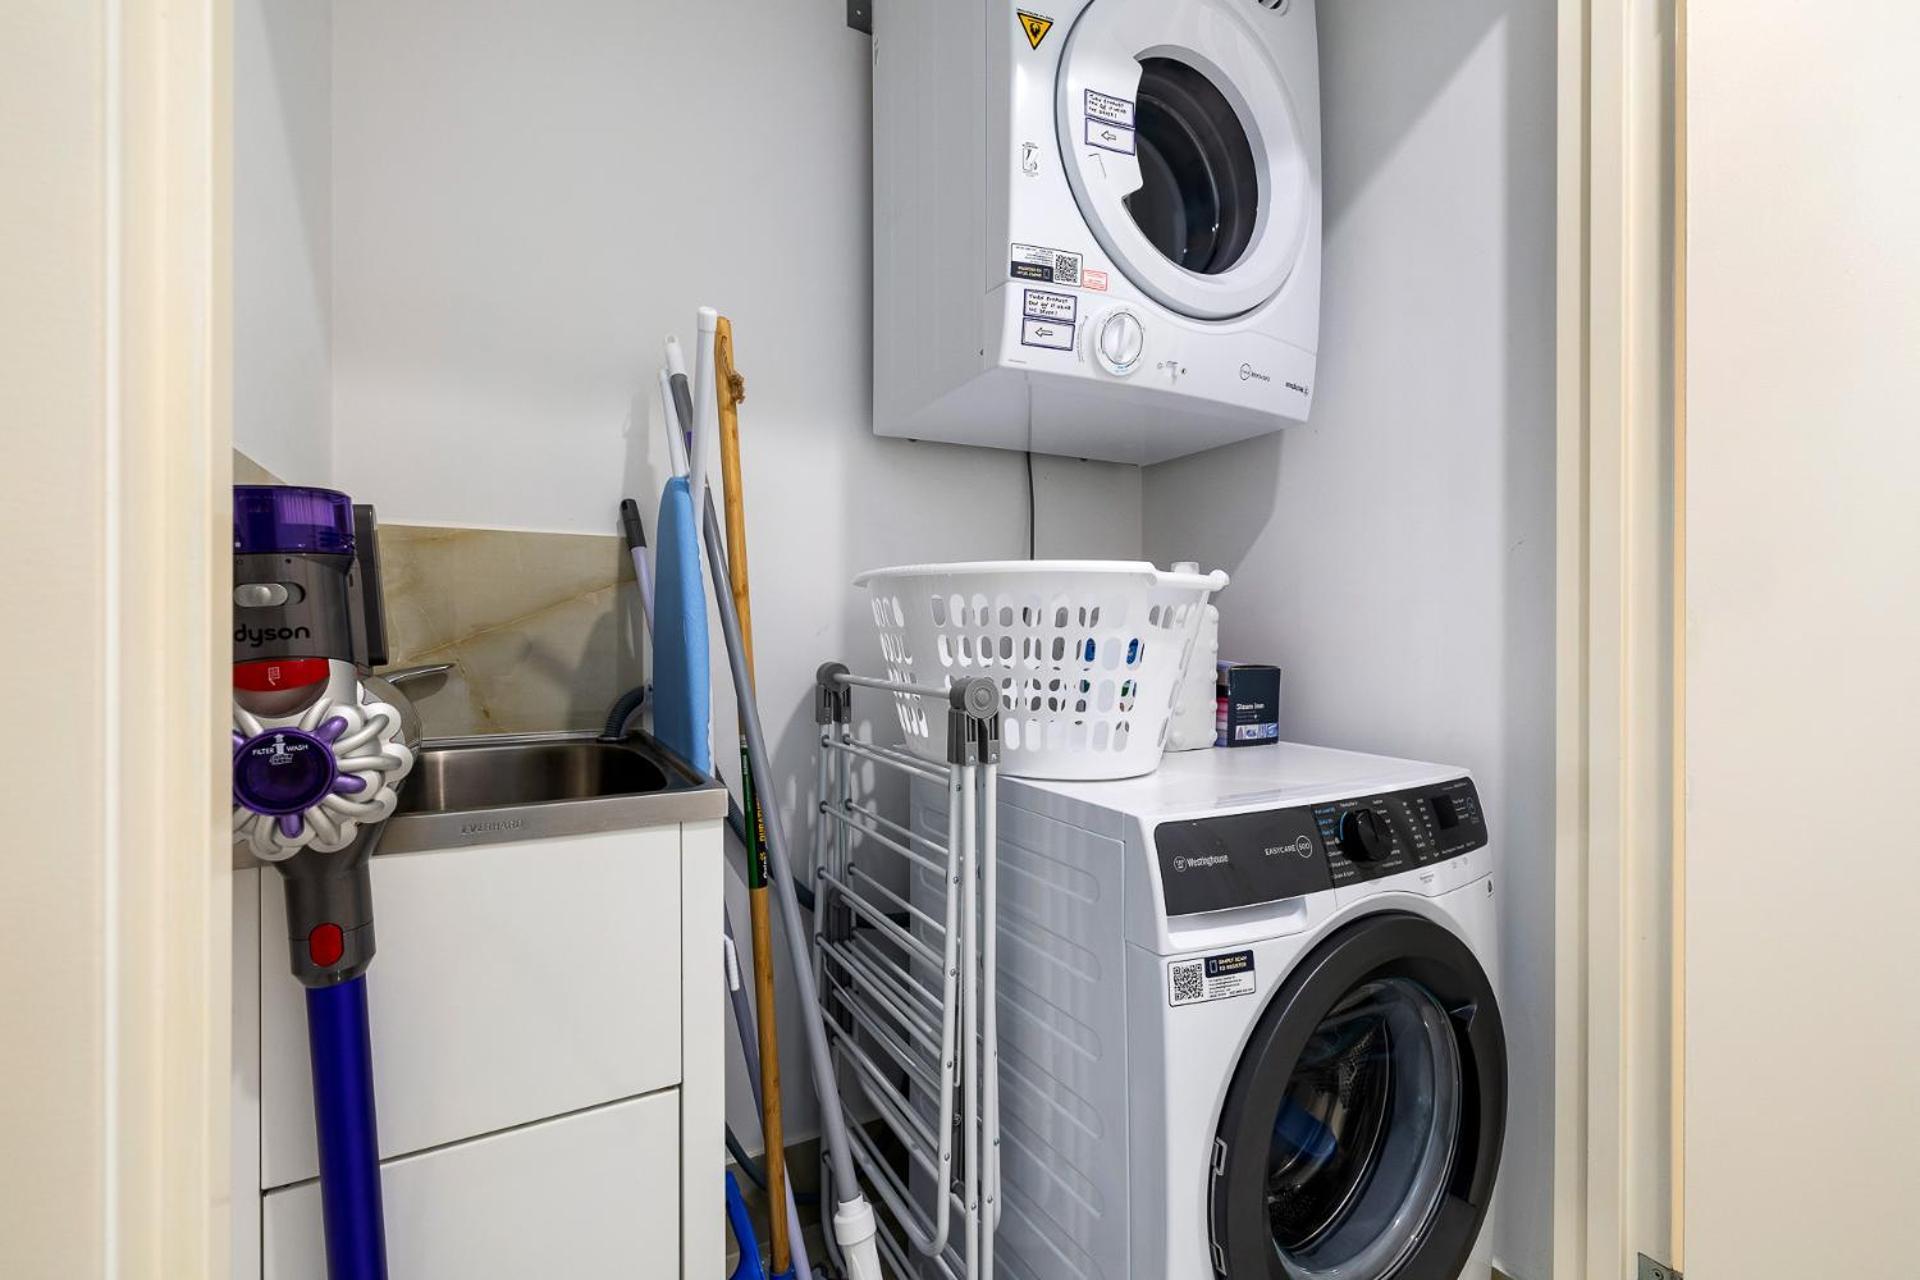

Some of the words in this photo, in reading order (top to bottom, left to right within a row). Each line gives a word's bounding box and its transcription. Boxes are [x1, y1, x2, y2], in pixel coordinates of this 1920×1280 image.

[234, 623, 310, 648] dyson
[252, 746, 275, 757] FILTER
[286, 744, 308, 753] WASH
[1264, 844, 1297, 856] EASYCARE
[1187, 855, 1228, 868] Westinghouse
